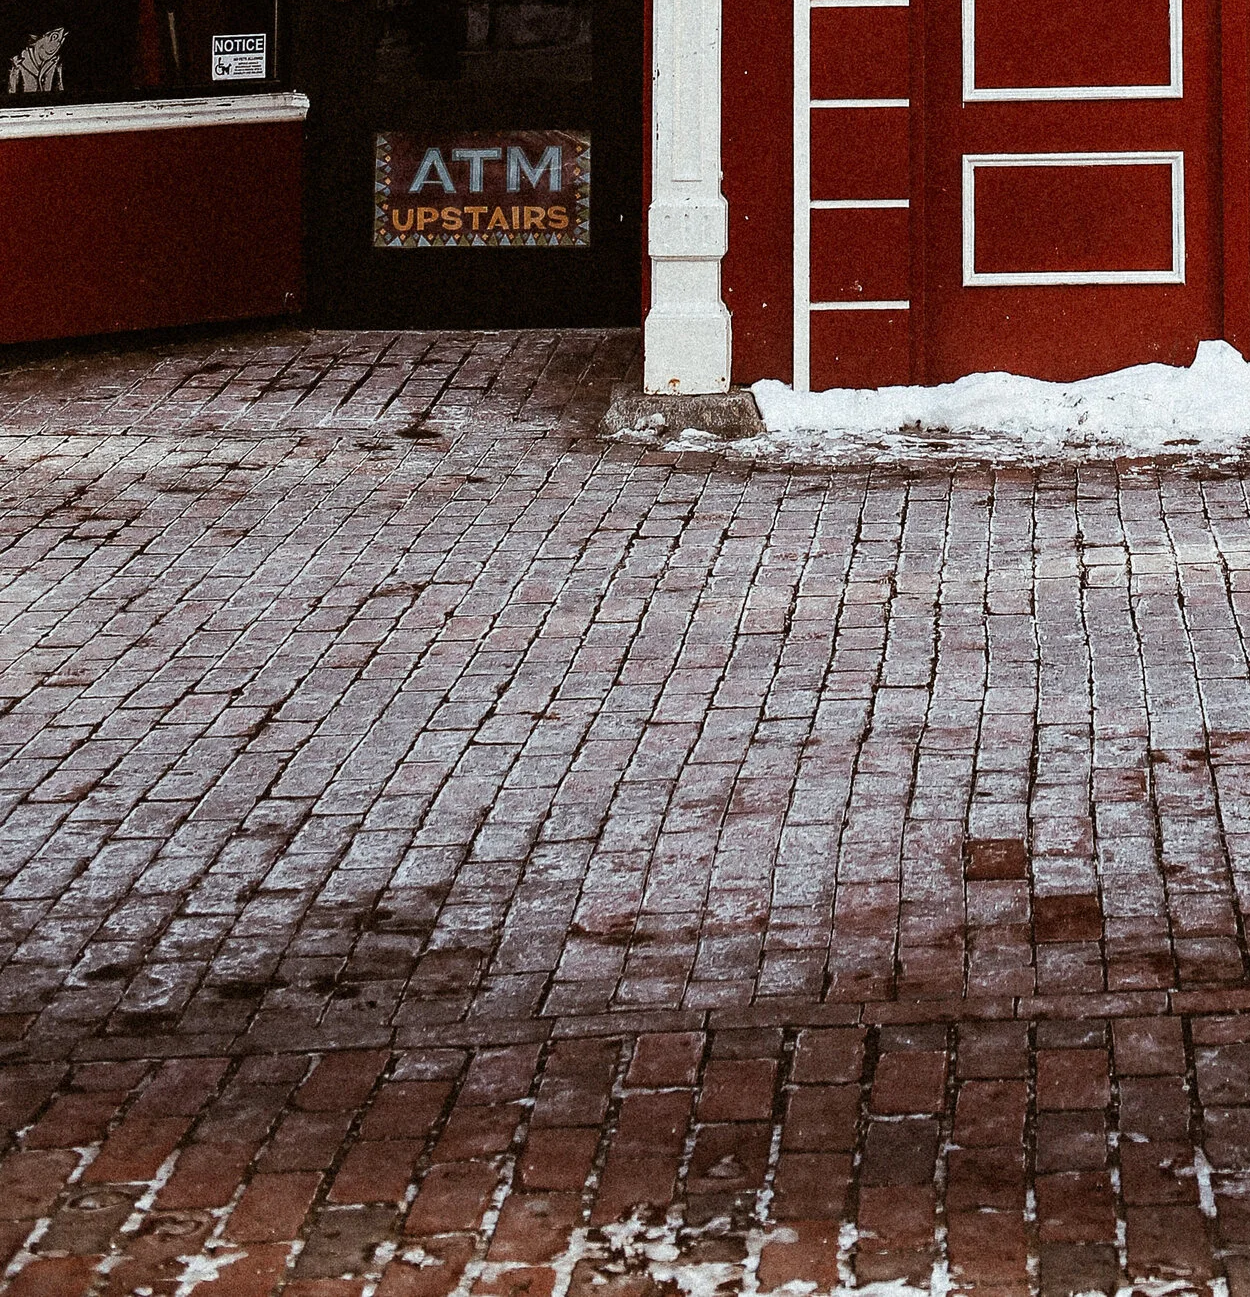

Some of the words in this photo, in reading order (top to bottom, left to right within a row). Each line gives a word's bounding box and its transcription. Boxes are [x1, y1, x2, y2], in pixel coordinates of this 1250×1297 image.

[215, 38, 263, 53] NOTICE
[408, 145, 564, 194] ATM
[391, 204, 570, 234] UPSTAIRS
